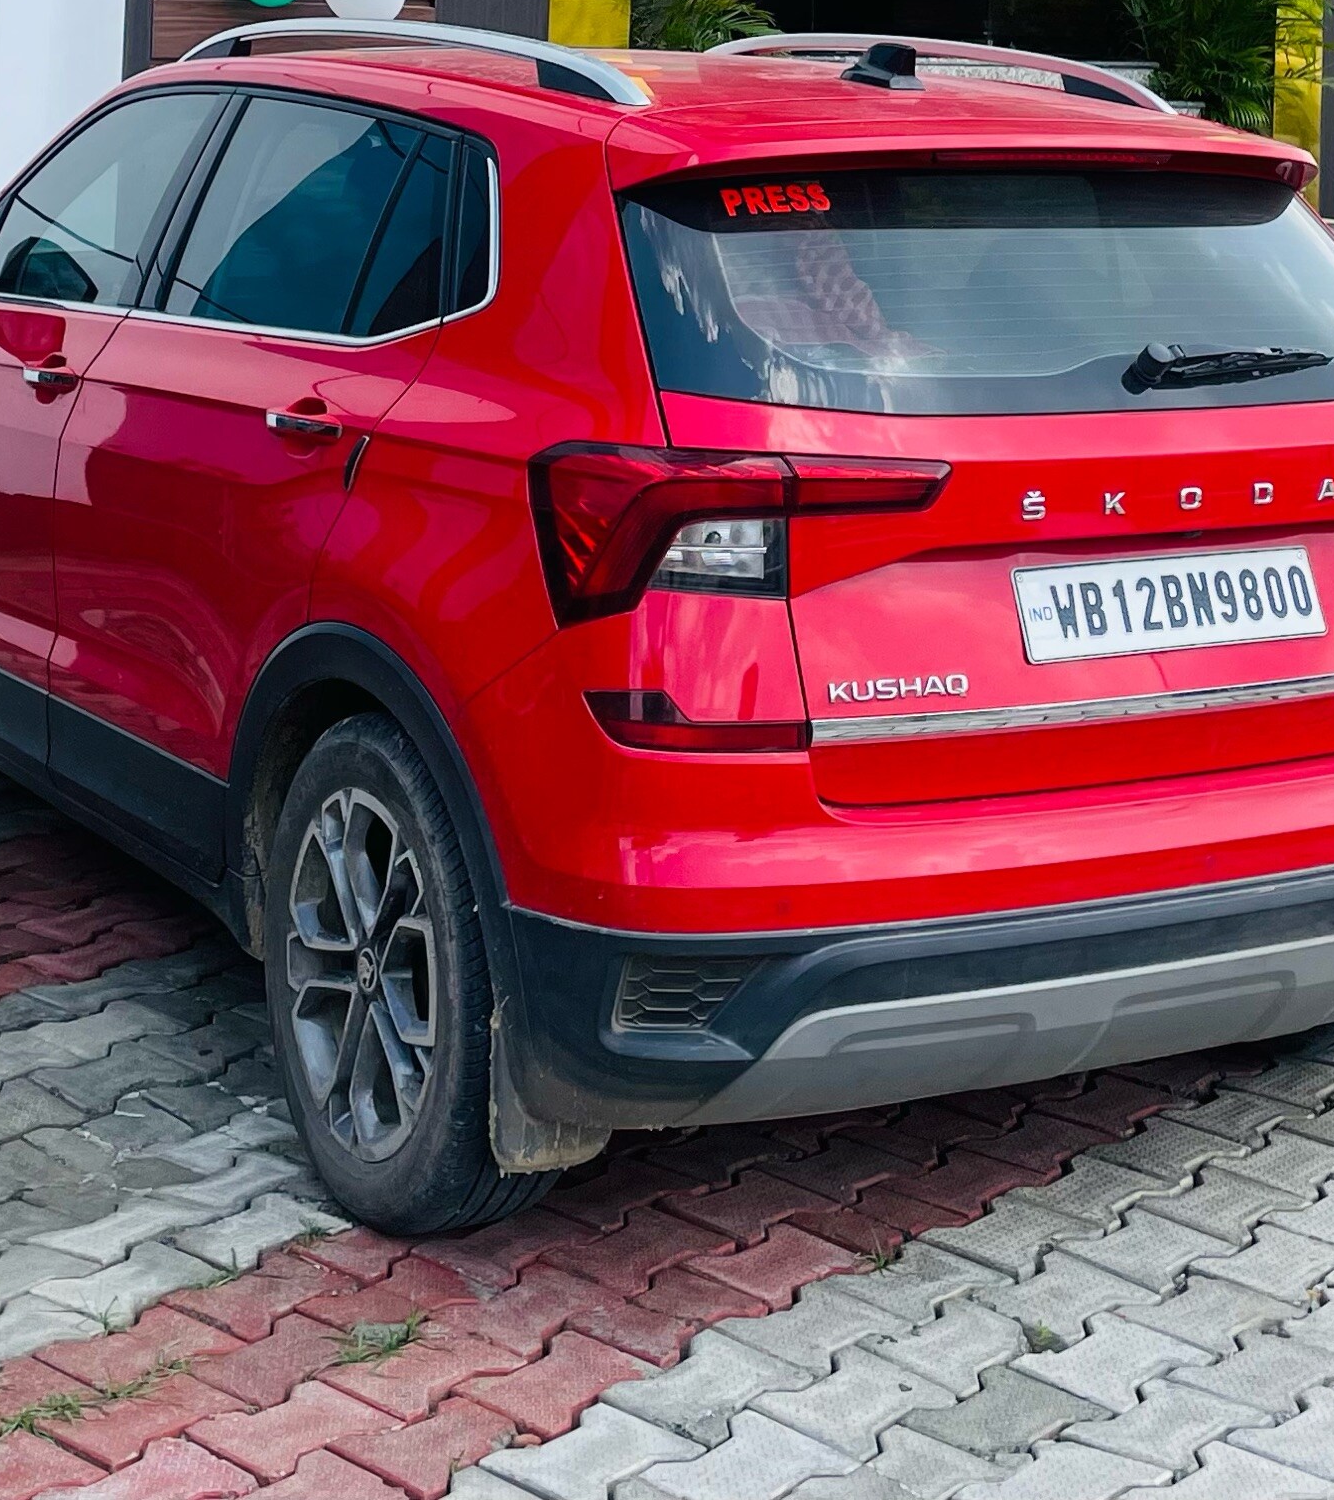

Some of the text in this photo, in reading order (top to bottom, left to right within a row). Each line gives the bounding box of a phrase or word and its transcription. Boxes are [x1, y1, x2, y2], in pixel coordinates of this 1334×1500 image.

[720, 183, 831, 217] PRESS
[1028, 605, 1054, 622] IND
[1050, 565, 1313, 639] WB12BN9800
[828, 673, 969, 703] KUSHAQ
